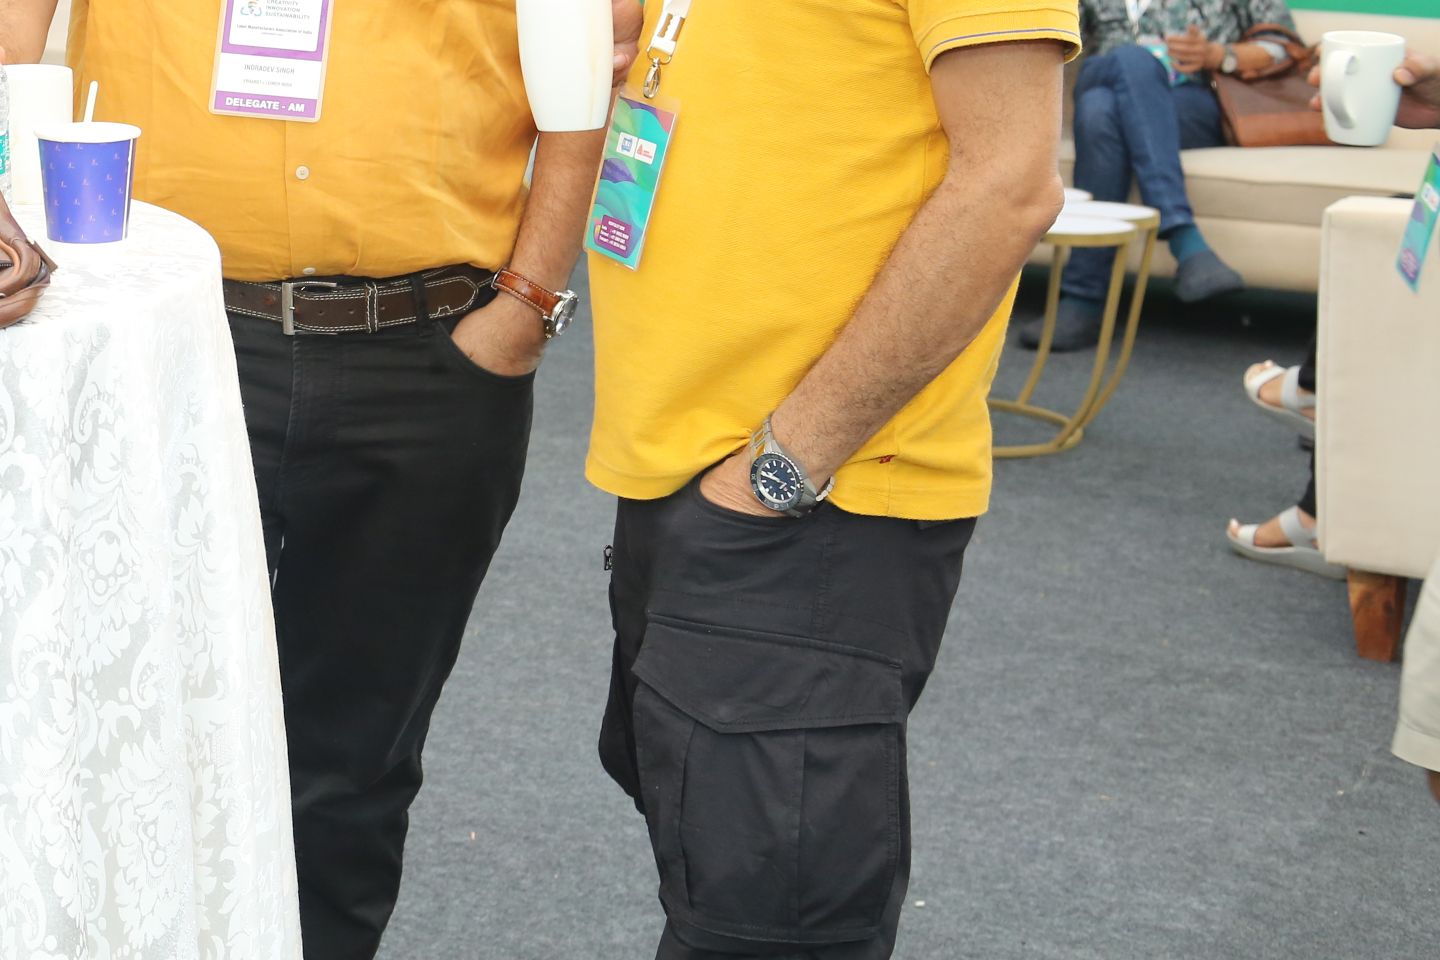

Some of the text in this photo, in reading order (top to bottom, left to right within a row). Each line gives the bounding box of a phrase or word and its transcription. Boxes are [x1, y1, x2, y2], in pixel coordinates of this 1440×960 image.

[265, 5, 301, 13] INNOVATION
[265, 11, 311, 20] SUSTAINABILITY
[225, 97, 280, 110] DELEGATE
[288, 103, 305, 113] AM
